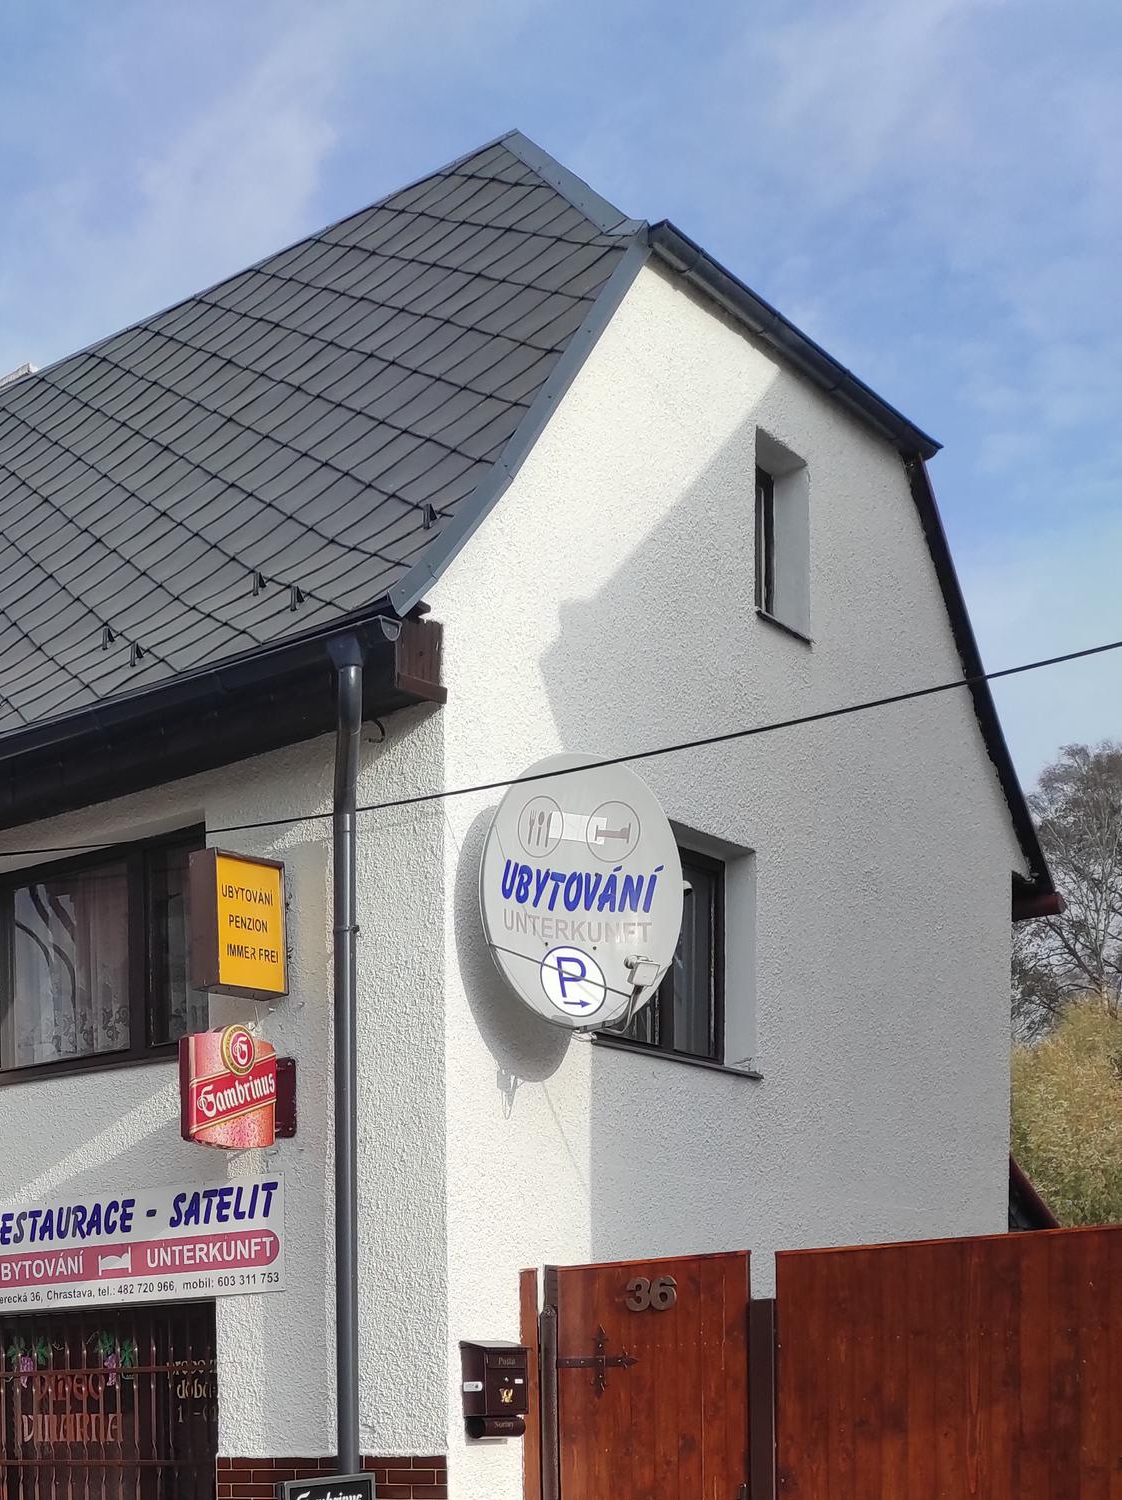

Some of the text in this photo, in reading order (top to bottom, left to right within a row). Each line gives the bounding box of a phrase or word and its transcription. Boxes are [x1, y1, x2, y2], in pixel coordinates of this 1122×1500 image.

[222, 884, 273, 906] UBYTOVÁNÍ
[501, 859, 664, 913] UBYTOVÁNÍ
[229, 914, 268, 933] PENZION
[504, 909, 652, 943] UNTERKUNFT
[227, 943, 278, 963] IMMER FREI
[557, 956, 586, 998] P
[197, 1073, 275, 1118] Gambrinus
[169, 1182, 278, 1228] SATELIT
[146, 1237, 274, 1268] UNTERKUNFT
[30, 1292, 44, 1303] 36,
[46, 1287, 95, 1300] Chrastava,
[98, 1285, 116, 1297] tel.:
[117, 1284, 134, 1295] 482
[138, 1282, 155, 1293] 720
[158, 1281, 177, 1293] 966,
[182, 1278, 214, 1290] mobil:
[217, 1275, 236, 1287] 603
[239, 1274, 257, 1285] 311
[260, 1272, 279, 1284] 753
[627, 1275, 677, 1312] 36
